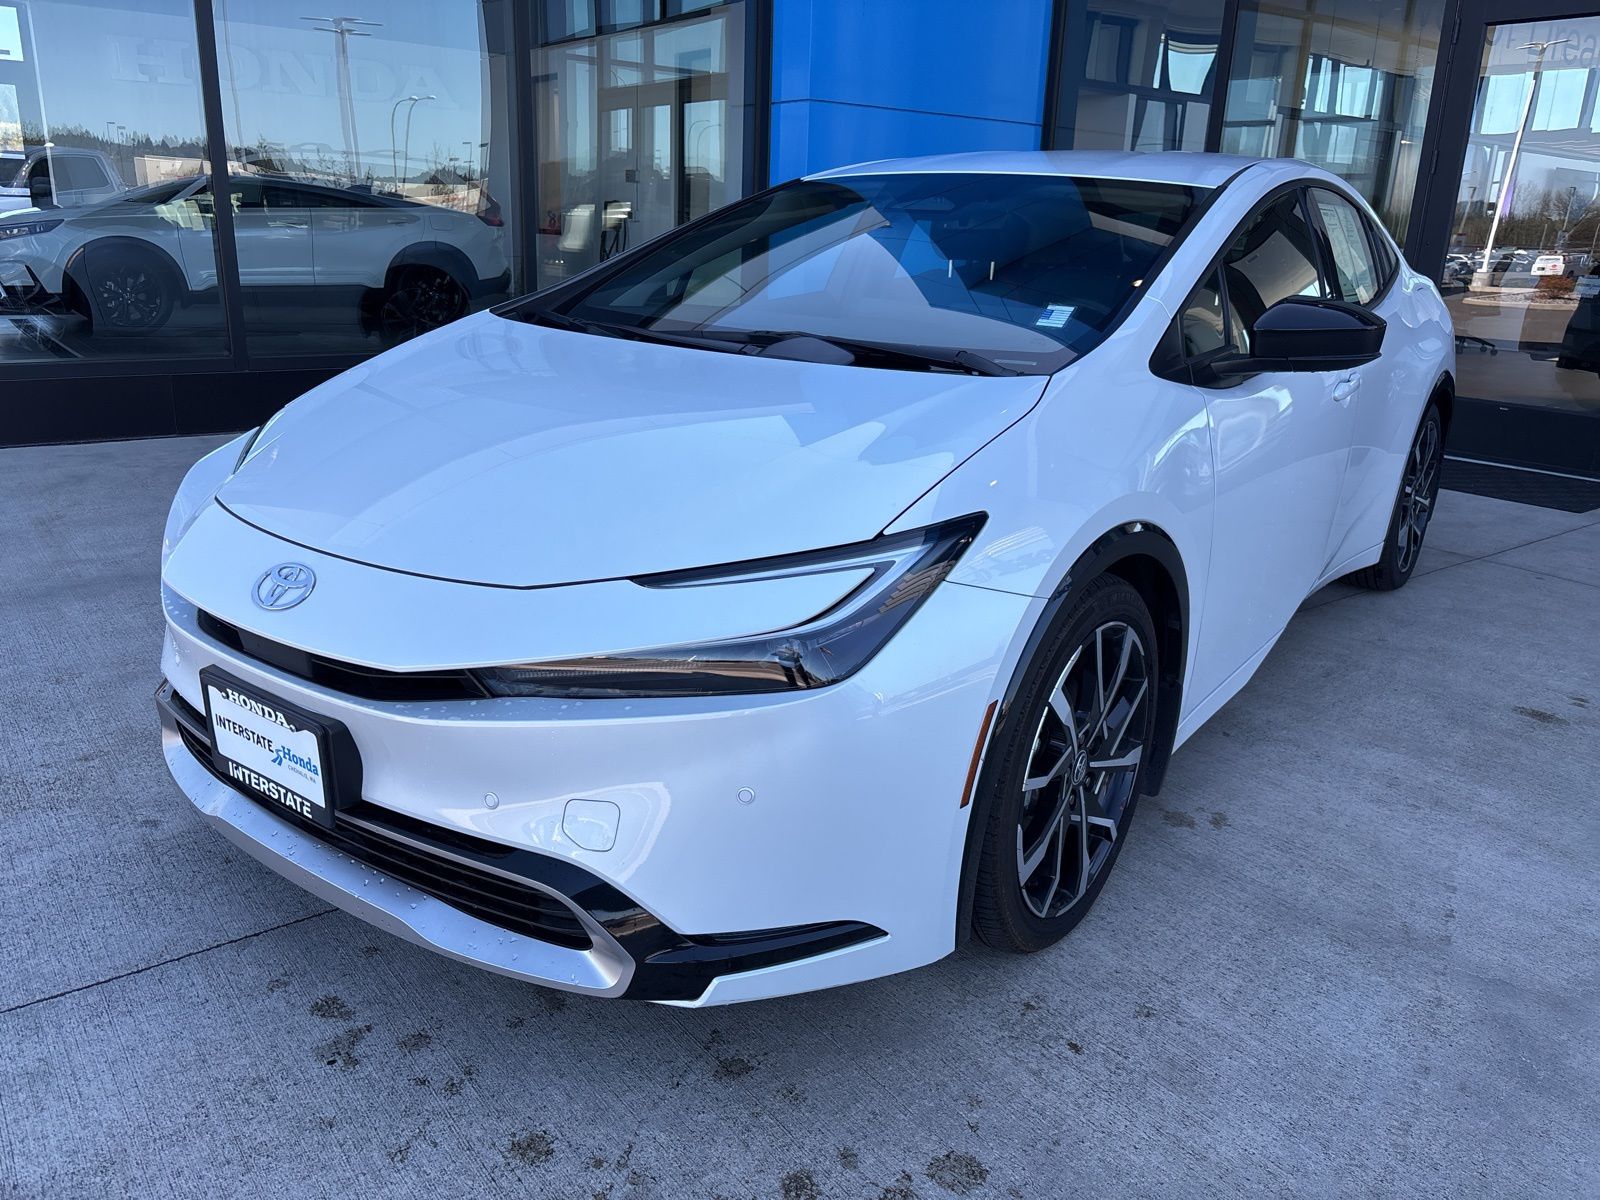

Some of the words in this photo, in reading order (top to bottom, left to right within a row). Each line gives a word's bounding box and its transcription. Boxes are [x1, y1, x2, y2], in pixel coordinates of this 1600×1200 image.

[106, 34, 463, 111] HONDA
[226, 688, 290, 730] HONDA
[215, 713, 274, 753] INTERSTATE
[281, 745, 319, 776] Honda
[228, 761, 312, 819] INTERSTATE
